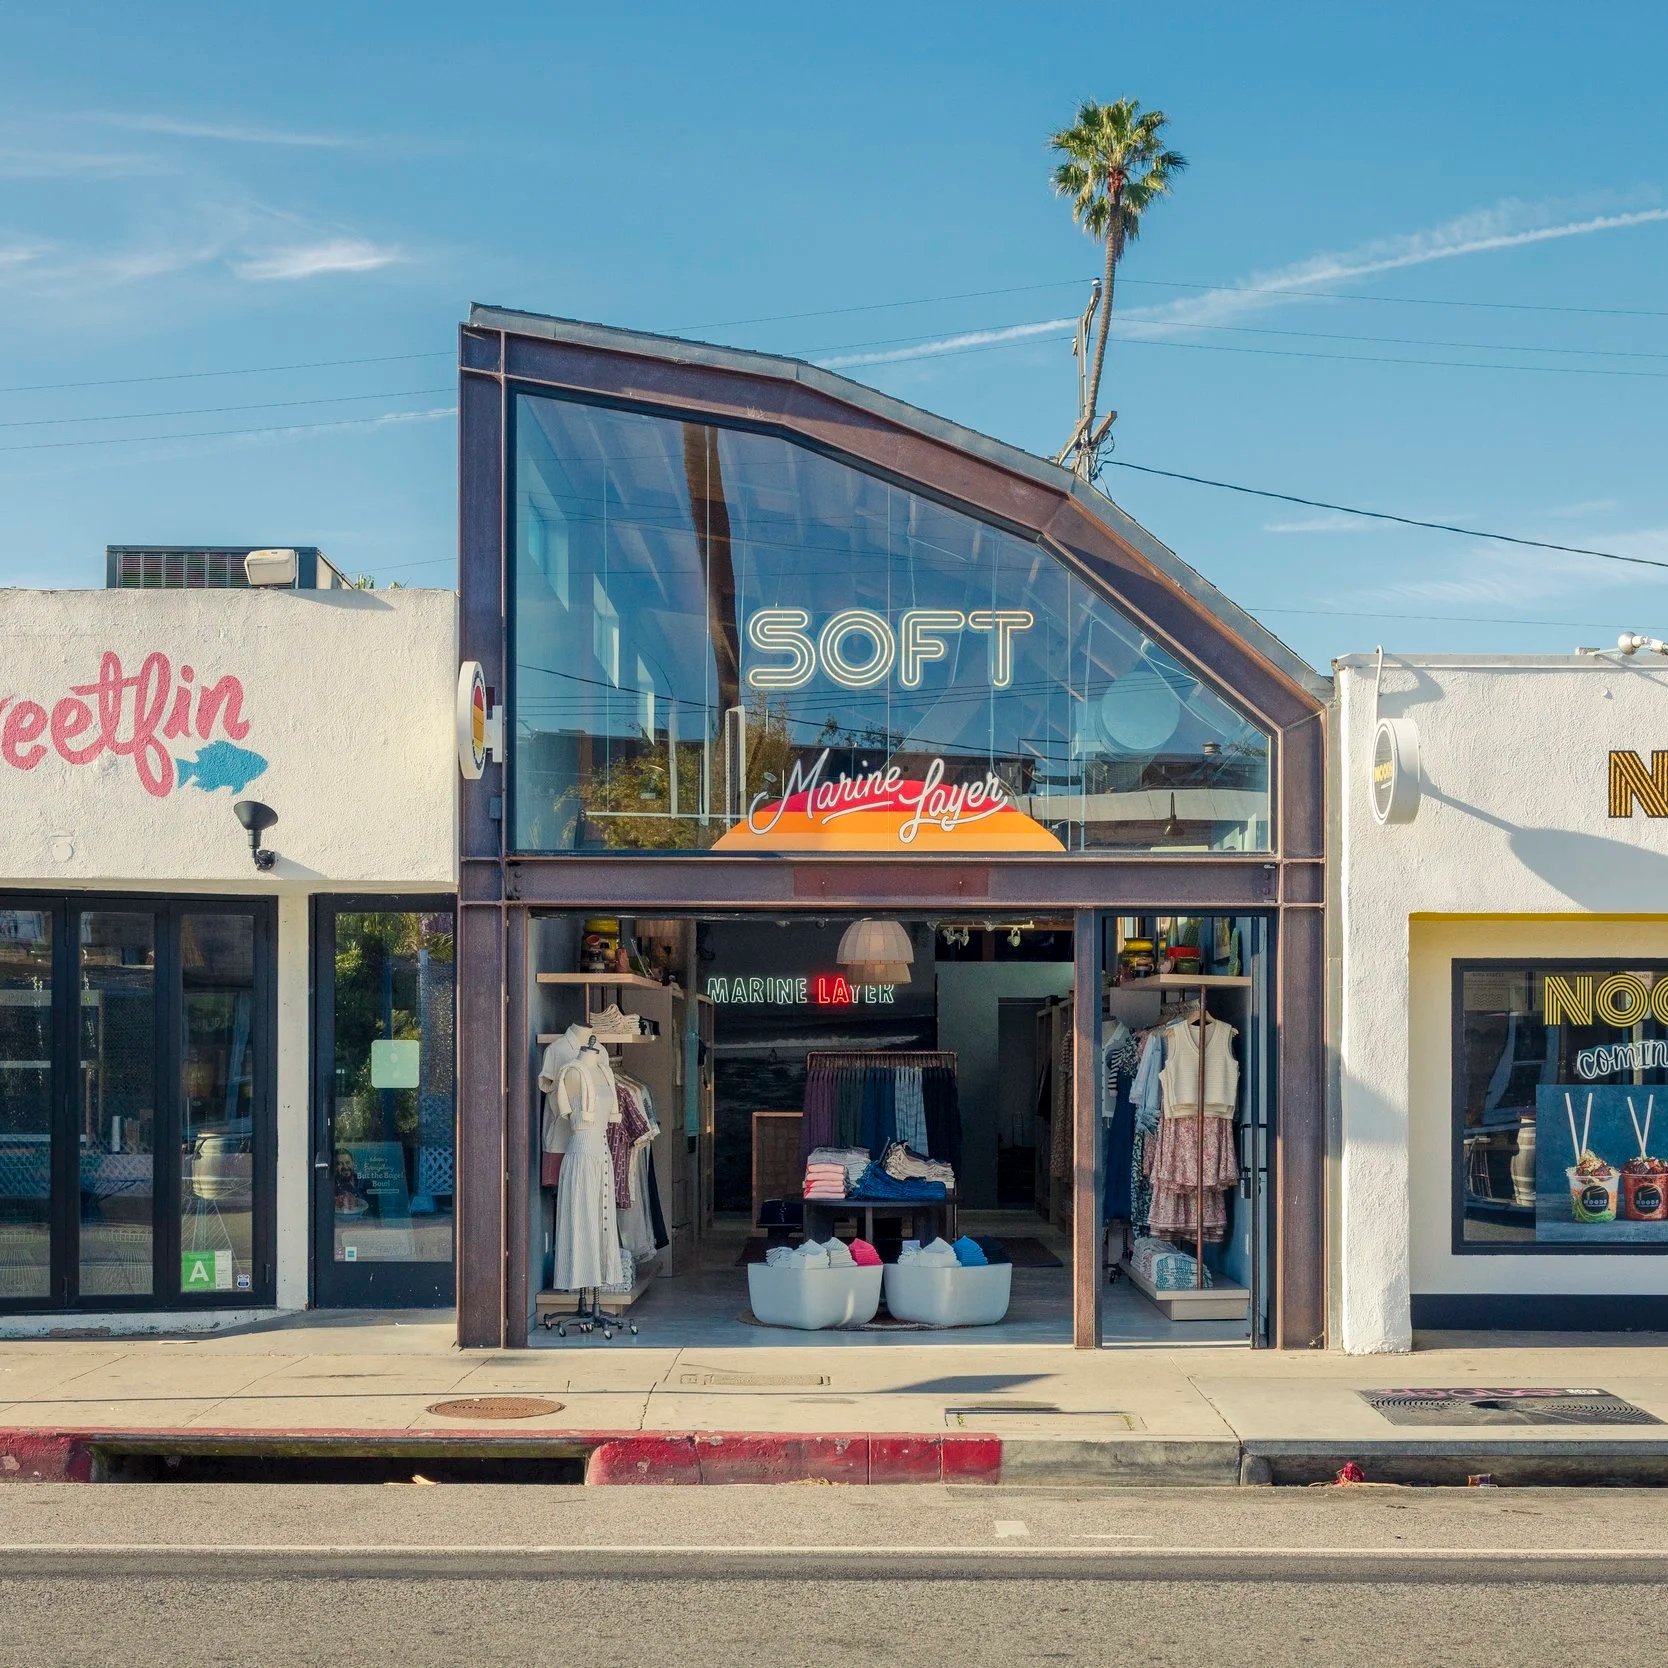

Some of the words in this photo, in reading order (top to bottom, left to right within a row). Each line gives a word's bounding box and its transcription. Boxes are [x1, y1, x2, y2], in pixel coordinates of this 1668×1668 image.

[749, 609, 1034, 686] SOFT
[0, 651, 249, 797] eetfin
[748, 747, 904, 835] Marine
[898, 757, 1009, 844] Layer
[707, 977, 808, 1005] MARINE
[818, 977, 895, 1005] LAYER
[189, 1260, 210, 1282] A
